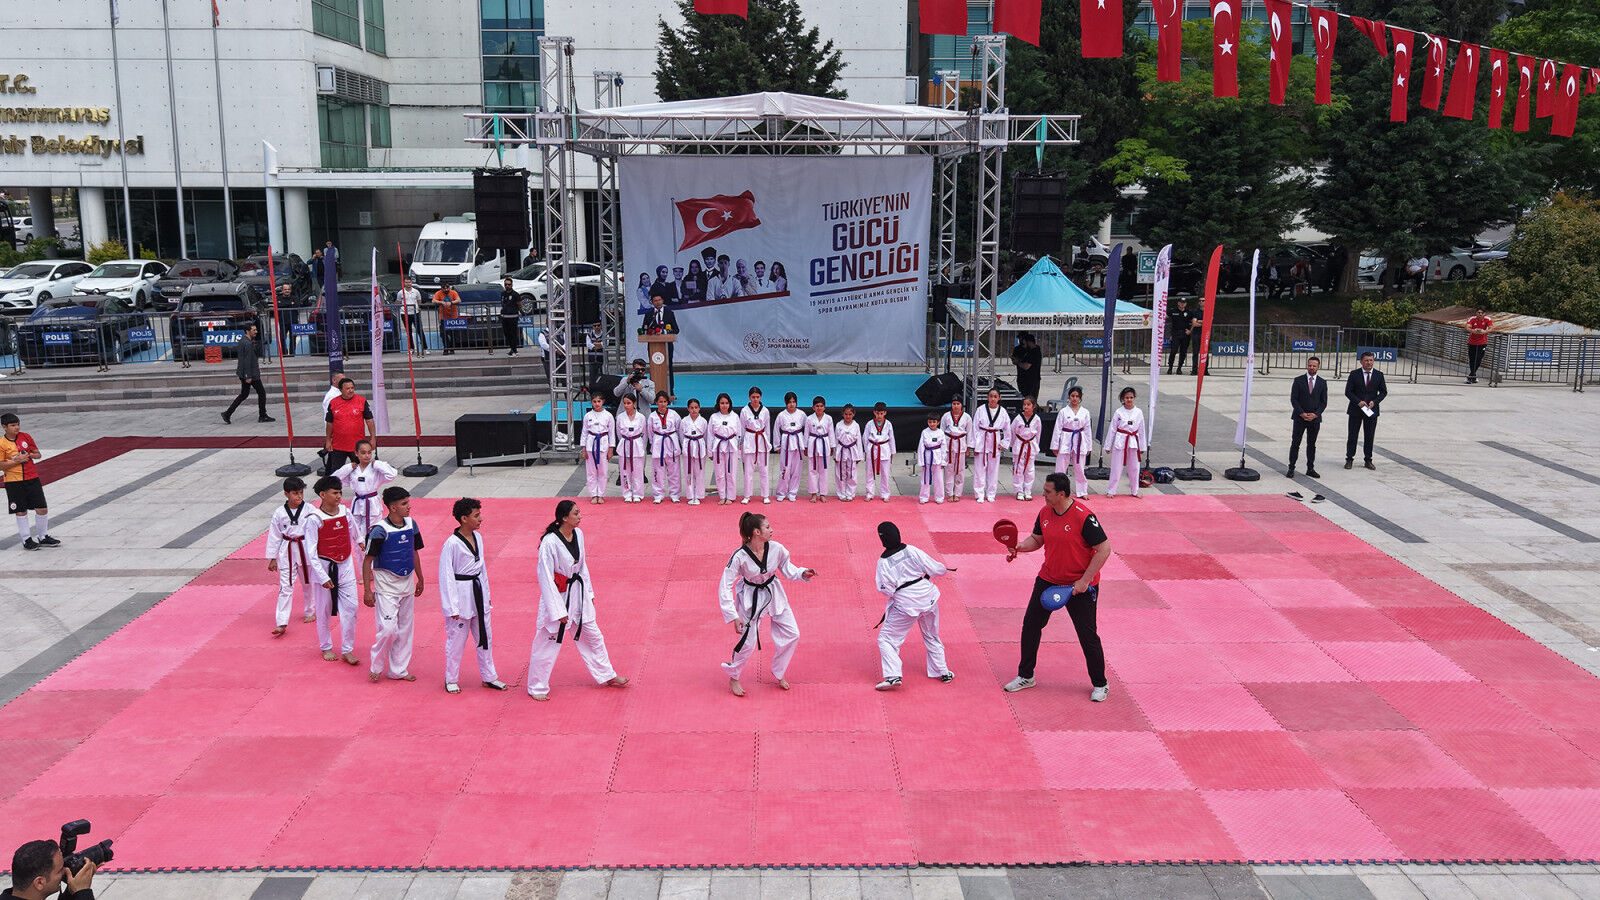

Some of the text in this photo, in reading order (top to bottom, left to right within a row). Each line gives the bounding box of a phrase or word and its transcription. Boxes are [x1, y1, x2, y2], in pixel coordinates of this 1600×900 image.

[31, 135, 144, 159] Belediyesi
[822, 192, 910, 221] TÜRKİYE'NİN
[832, 215, 899, 251] GÜCÜ
[810, 242, 920, 286] GENÇLİĞİ
[818, 297, 835, 305] MAYIS
[869, 290, 884, 298] ANMA
[886, 287, 909, 296] GENÇLİK
[818, 306, 833, 315] SPOR
[871, 298, 888, 306] KUTLU
[1007, 314, 1052, 326] Kahramanmaraş
[1053, 314, 1084, 326] Büyükşehir
[1085, 314, 1104, 326] Belediy
[46, 333, 70, 341] POLİS
[206, 332, 242, 344] POLİS
[1218, 344, 1245, 354] POLİS
[1371, 349, 1393, 360] OLİS
